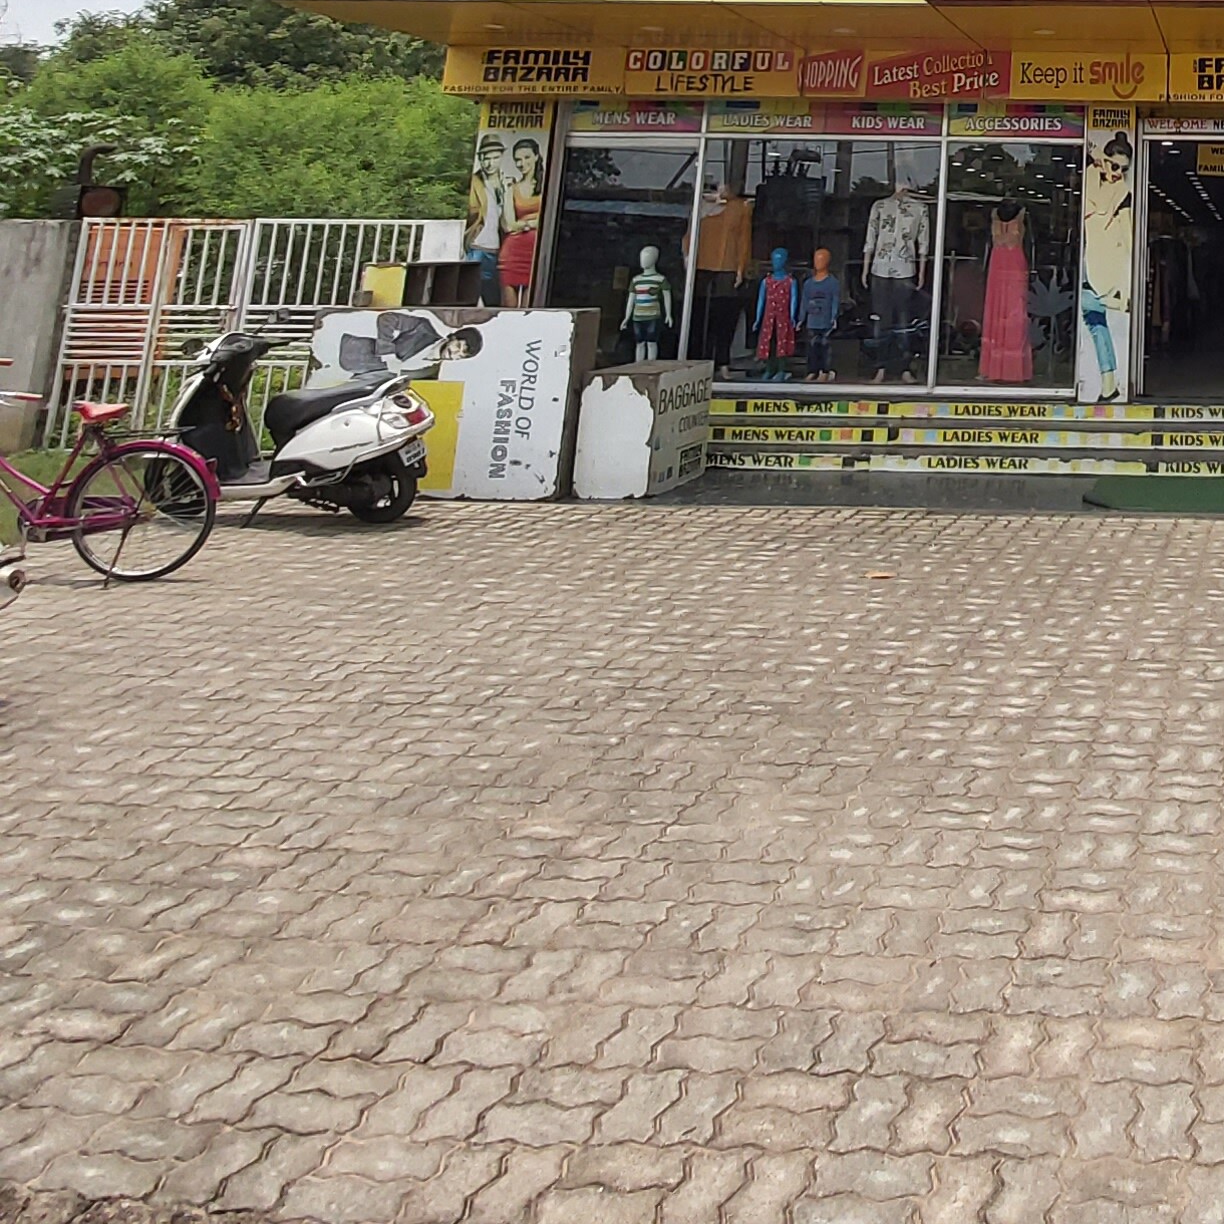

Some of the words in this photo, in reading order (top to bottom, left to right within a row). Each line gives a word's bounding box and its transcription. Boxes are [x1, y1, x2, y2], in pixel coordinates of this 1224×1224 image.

[486, 50, 592, 66] FAMILY
[628, 50, 790, 72] COLORFUL
[483, 66, 589, 83] BAZAAR
[873, 62, 920, 86] Latest
[1020, 62, 1067, 88] Keep
[1072, 62, 1084, 84] it
[583, 86, 621, 94] FAMILY
[655, 73, 754, 93] LIFESTYLE
[909, 80, 948, 98] Best
[952, 71, 1000, 93] Price
[489, 101, 546, 114] FAMILY
[1093, 109, 1131, 119] FAMILY
[487, 114, 544, 128] BAZAAR
[592, 111, 631, 125] MENS
[635, 111, 676, 125] WEAR
[722, 114, 769, 126] LADIES
[773, 115, 812, 127] WEAR
[851, 115, 884, 129] KIDS
[890, 116, 925, 130] WEAR
[965, 117, 1062, 131] ACCESSORIES
[1092, 119, 1131, 128] BAZAAR
[519, 340, 542, 411] WORLD
[658, 378, 712, 415] BAGGAGE
[753, 401, 790, 413] MENS
[954, 404, 1005, 416] LADIES
[1007, 405, 1047, 417] WEAR
[1170, 408, 1204, 419] KIDS
[489, 379, 517, 478] FASHION
[514, 416, 532, 440] OF
[731, 429, 769, 440] MENS
[774, 430, 816, 441] WEAR
[942, 430, 993, 443] LADIES
[997, 431, 1040, 444] WEAR
[1169, 435, 1204, 446] KIDS
[706, 454, 746, 466] MENS
[751, 454, 795, 467] WEAR
[927, 457, 980, 469] LADIES
[985, 457, 1028, 470] WEAR
[1165, 462, 1201, 474] KIDS
